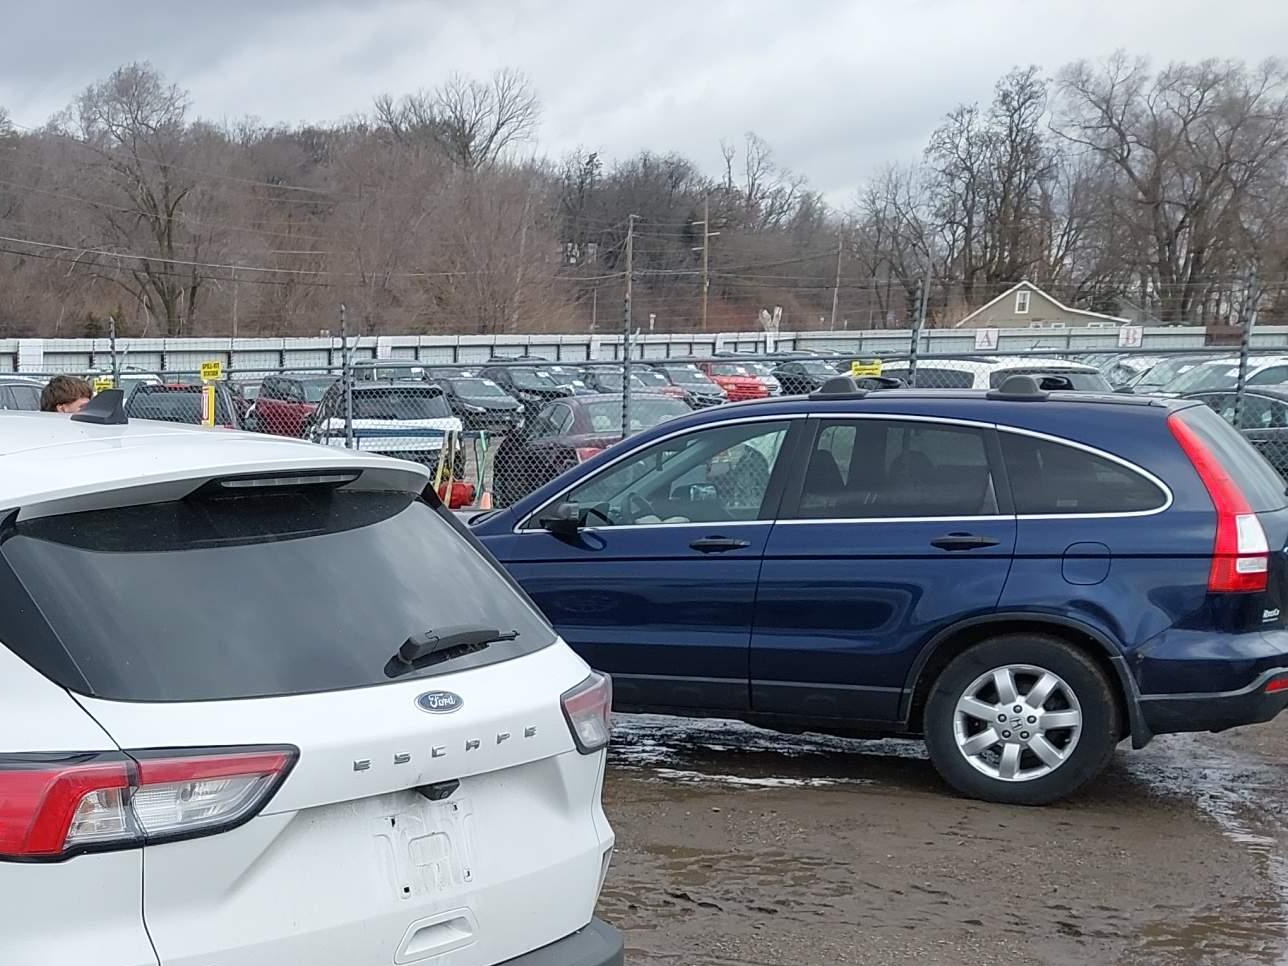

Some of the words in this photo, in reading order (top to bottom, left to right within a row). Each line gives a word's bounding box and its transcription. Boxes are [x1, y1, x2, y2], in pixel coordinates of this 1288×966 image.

[979, 329, 993, 347] A
[428, 692, 456, 708] Ford
[353, 726, 537, 771] ESCAPE
